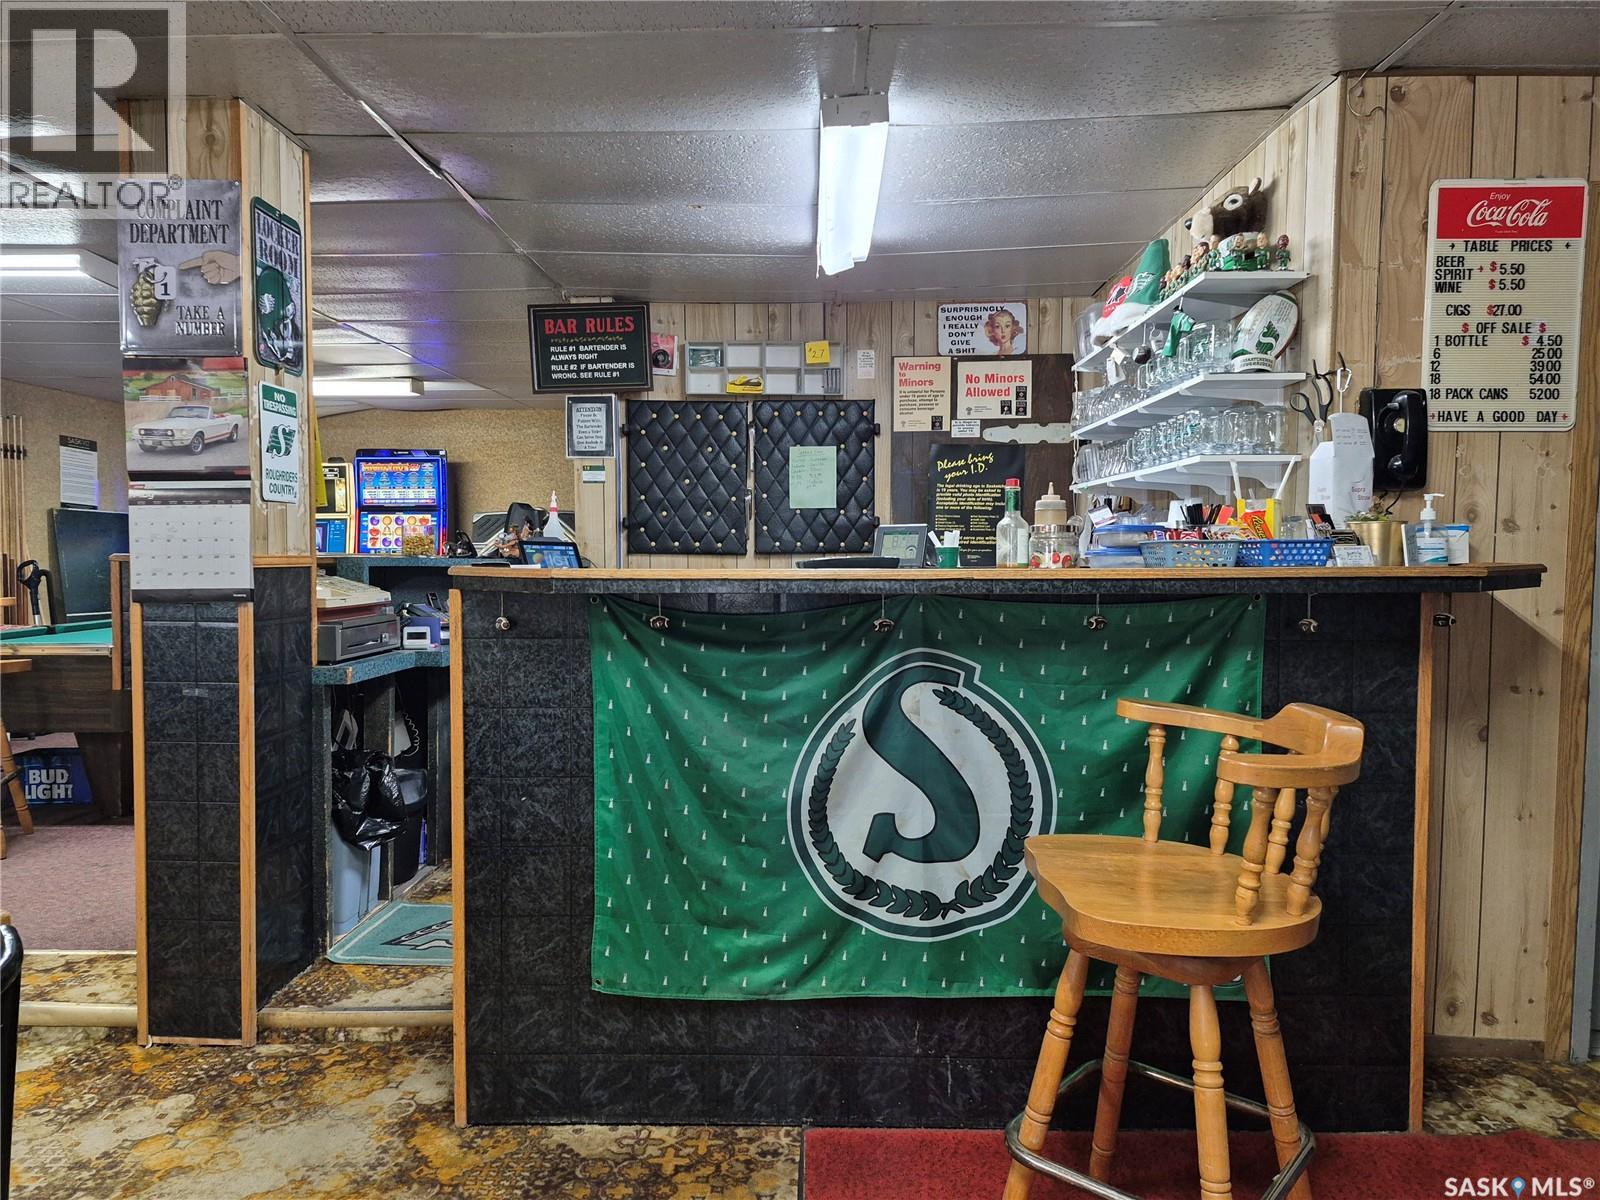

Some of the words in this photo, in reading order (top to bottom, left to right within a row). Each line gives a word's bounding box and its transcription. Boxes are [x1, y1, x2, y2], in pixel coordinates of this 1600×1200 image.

[1489, 192, 1511, 200] Enjoy
[137, 199, 224, 221] COMPLAINT
[129, 223, 229, 244] DEPARTMENT
[256, 212, 300, 256] LOCKER
[1463, 240, 1499, 252] TABLE
[1511, 240, 1553, 252] PRICES
[257, 237, 299, 278] ROOM
[1436, 256, 1465, 268] BEER
[1434, 269, 1474, 280] SPIRIT
[160, 282, 170, 296] 1
[1434, 282, 1463, 293] WINE
[175, 306, 210, 320] TAKE
[216, 305, 226, 320] A
[1446, 304, 1471, 317] CIGS
[175, 322, 226, 336] NUMBER
[544, 319, 577, 335] BAR
[585, 316, 635, 333] RULES
[1476, 322, 1497, 334] OFF
[1501, 322, 1532, 334] SALE
[1434, 335, 1440, 347] 1
[1445, 335, 1488, 347] BOTTLE
[579, 344, 619, 352] BARTENDER
[1433, 348, 1441, 359] 6
[587, 362, 628, 370] BARTENDER
[898, 362, 941, 371] Warning
[1431, 360, 1441, 372] 12
[899, 379, 934, 387] Minors
[965, 374, 980, 384] No
[984, 373, 1025, 384] Minors
[1429, 373, 1441, 385] 18
[273, 392, 286, 403] NO
[965, 387, 1011, 397] Allowed
[1429, 388, 1441, 400] 18
[1446, 388, 1474, 400] PACK
[1479, 388, 1508, 400] CANS
[263, 400, 297, 417] TRESPASSING
[1438, 411, 1468, 422] HAVE
[1476, 411, 1484, 422] A
[1492, 411, 1525, 422] GOOD
[1536, 411, 1559, 422] DAY
[937, 458, 967, 472] Please
[967, 452, 994, 464] bring
[265, 468, 298, 484] ROUGHRIDERS
[944, 467, 969, 482] your
[971, 462, 988, 474] I.D.
[28, 769, 69, 784] BUD
[25, 784, 73, 800] LIGHT
